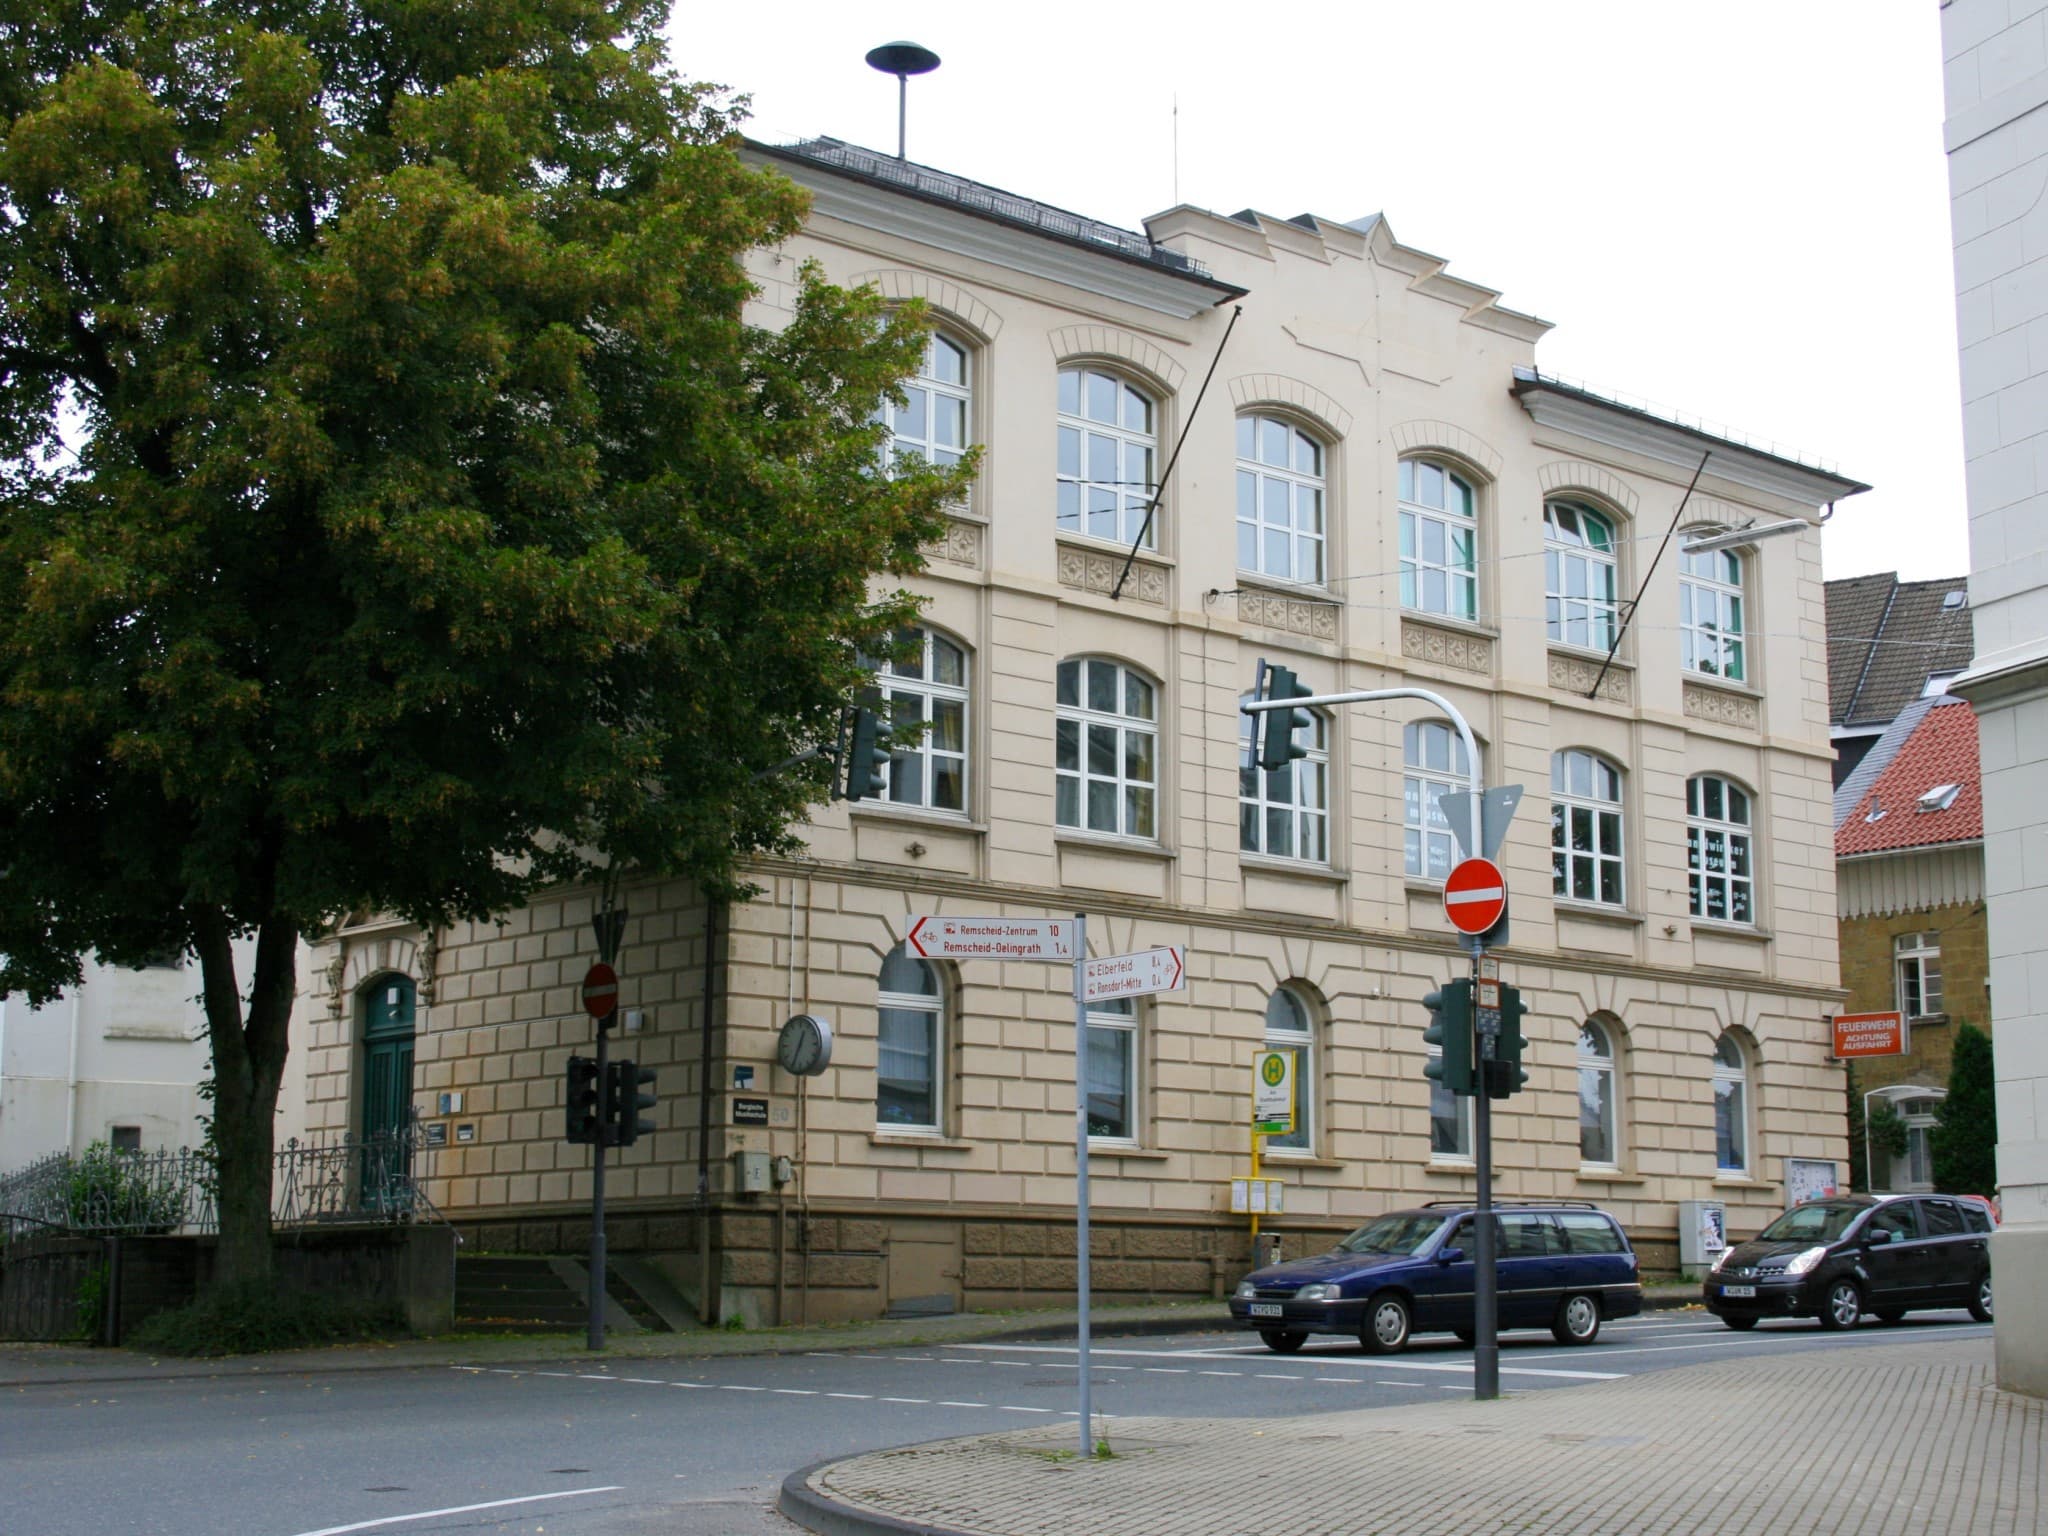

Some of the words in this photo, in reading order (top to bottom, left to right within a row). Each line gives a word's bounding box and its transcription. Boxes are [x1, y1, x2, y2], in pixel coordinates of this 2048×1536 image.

[960, 925, 1038, 937] Remscheid-Zentrum
[1049, 925, 1059, 937] 10
[943, 941, 1041, 956] Remscheid-Oelingrath
[1055, 942, 1068, 954] 1,4
[1097, 960, 1133, 976] Elberfeld
[1097, 977, 1142, 993] Ronsdorf-Mitte
[1838, 1019, 1896, 1033] FEUERWEHR
[1845, 1032, 1890, 1042] ACHTUNG
[1842, 1040, 1893, 1050] AUSFAHRT
[1268, 1061, 1279, 1079] H
